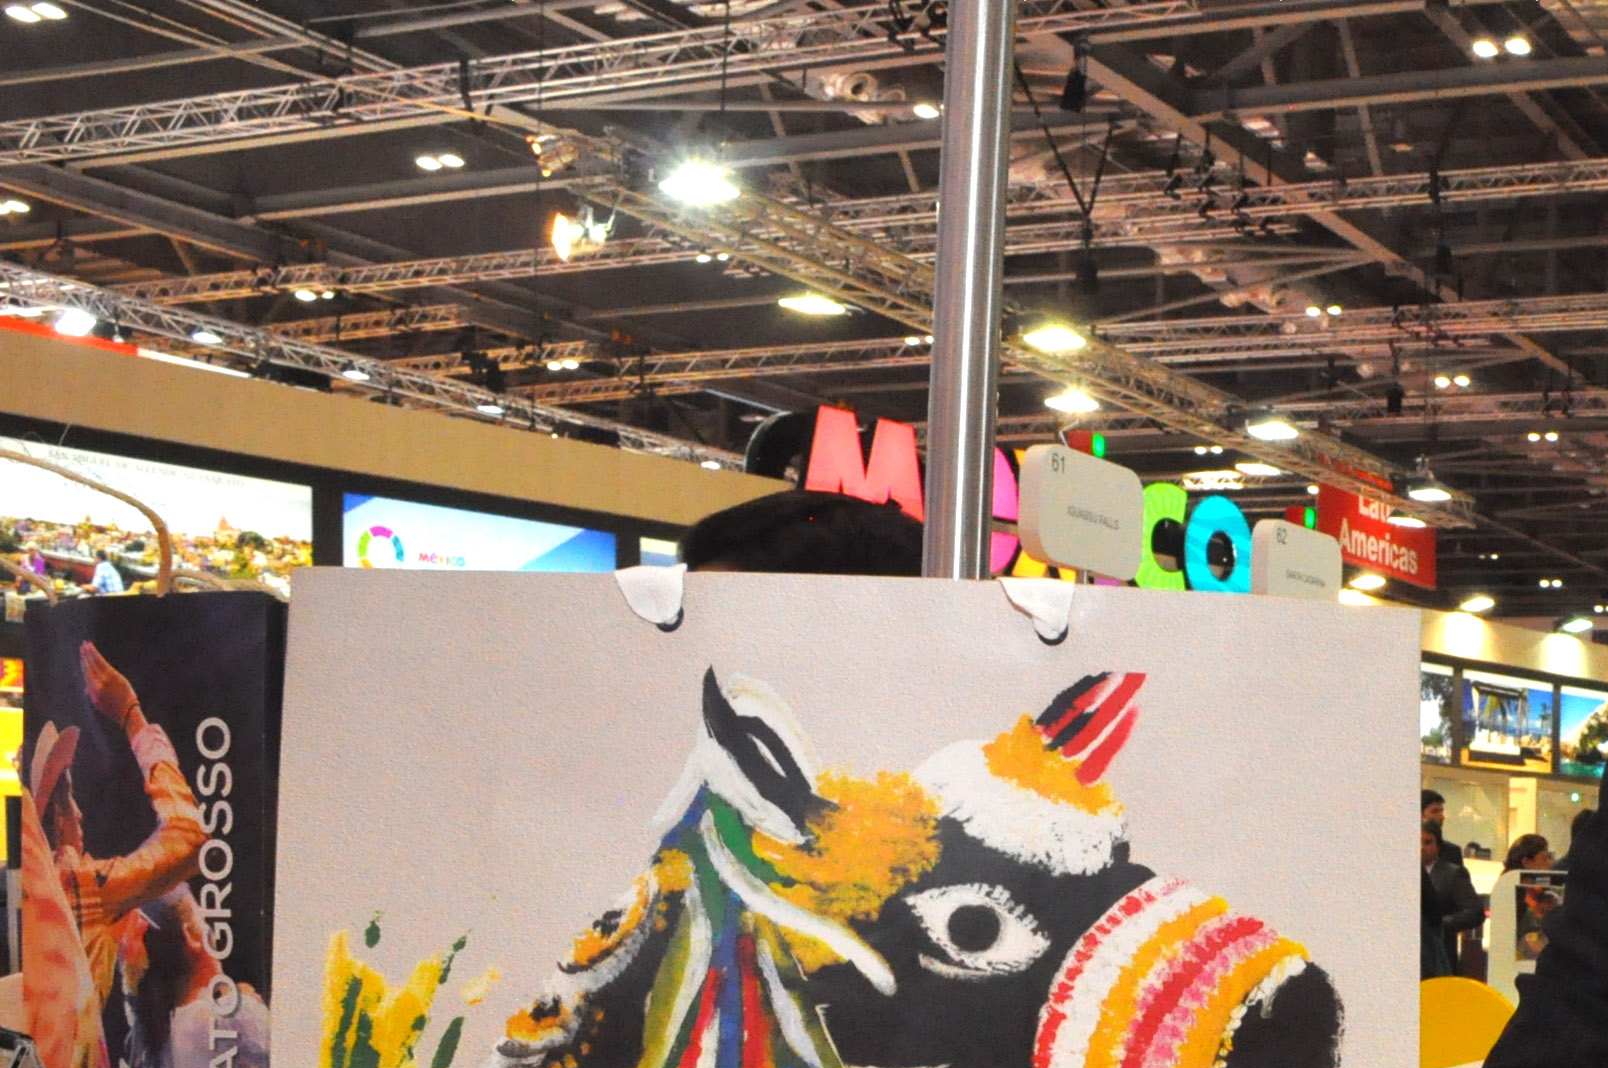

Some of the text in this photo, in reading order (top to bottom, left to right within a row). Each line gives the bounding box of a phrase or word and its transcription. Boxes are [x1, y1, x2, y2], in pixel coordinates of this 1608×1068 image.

[1051, 453, 1066, 474] 61
[1100, 514, 1120, 531] FALLS
[1276, 527, 1288, 545] 62
[1340, 517, 1419, 575] Americas
[195, 715, 234, 961] GROSSO
